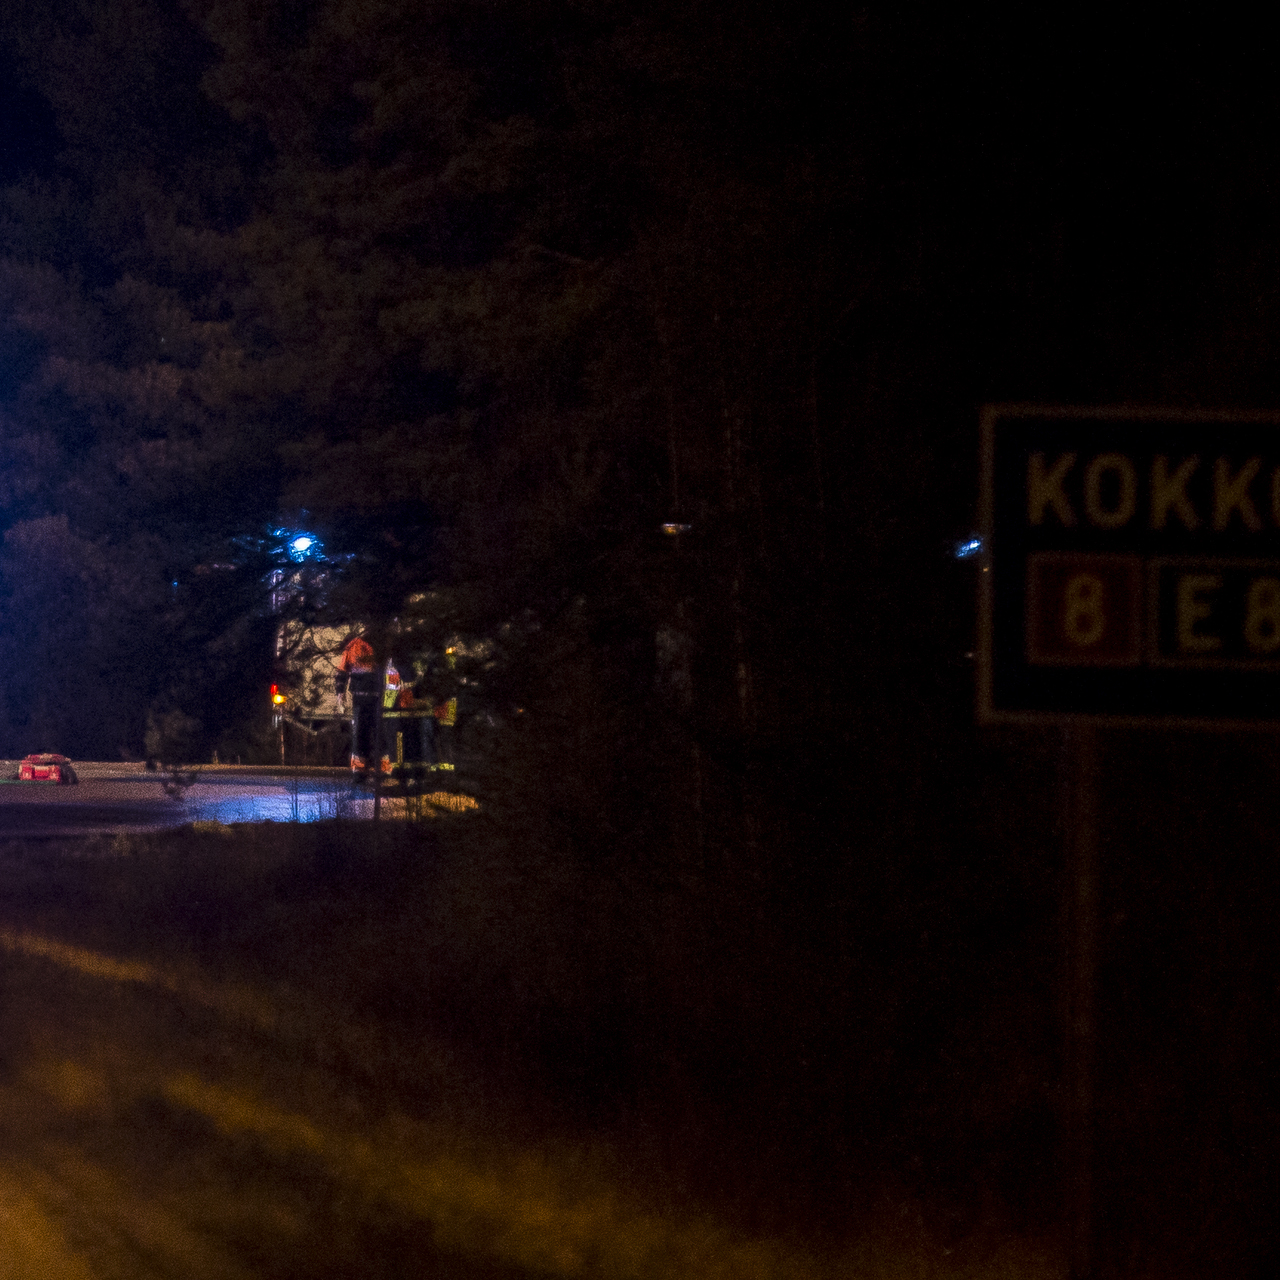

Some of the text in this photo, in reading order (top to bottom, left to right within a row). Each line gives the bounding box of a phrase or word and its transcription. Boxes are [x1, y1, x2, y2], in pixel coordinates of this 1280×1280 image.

[1026, 451, 1280, 532] KOKK
[1063, 574, 1280, 653] 8 E8
